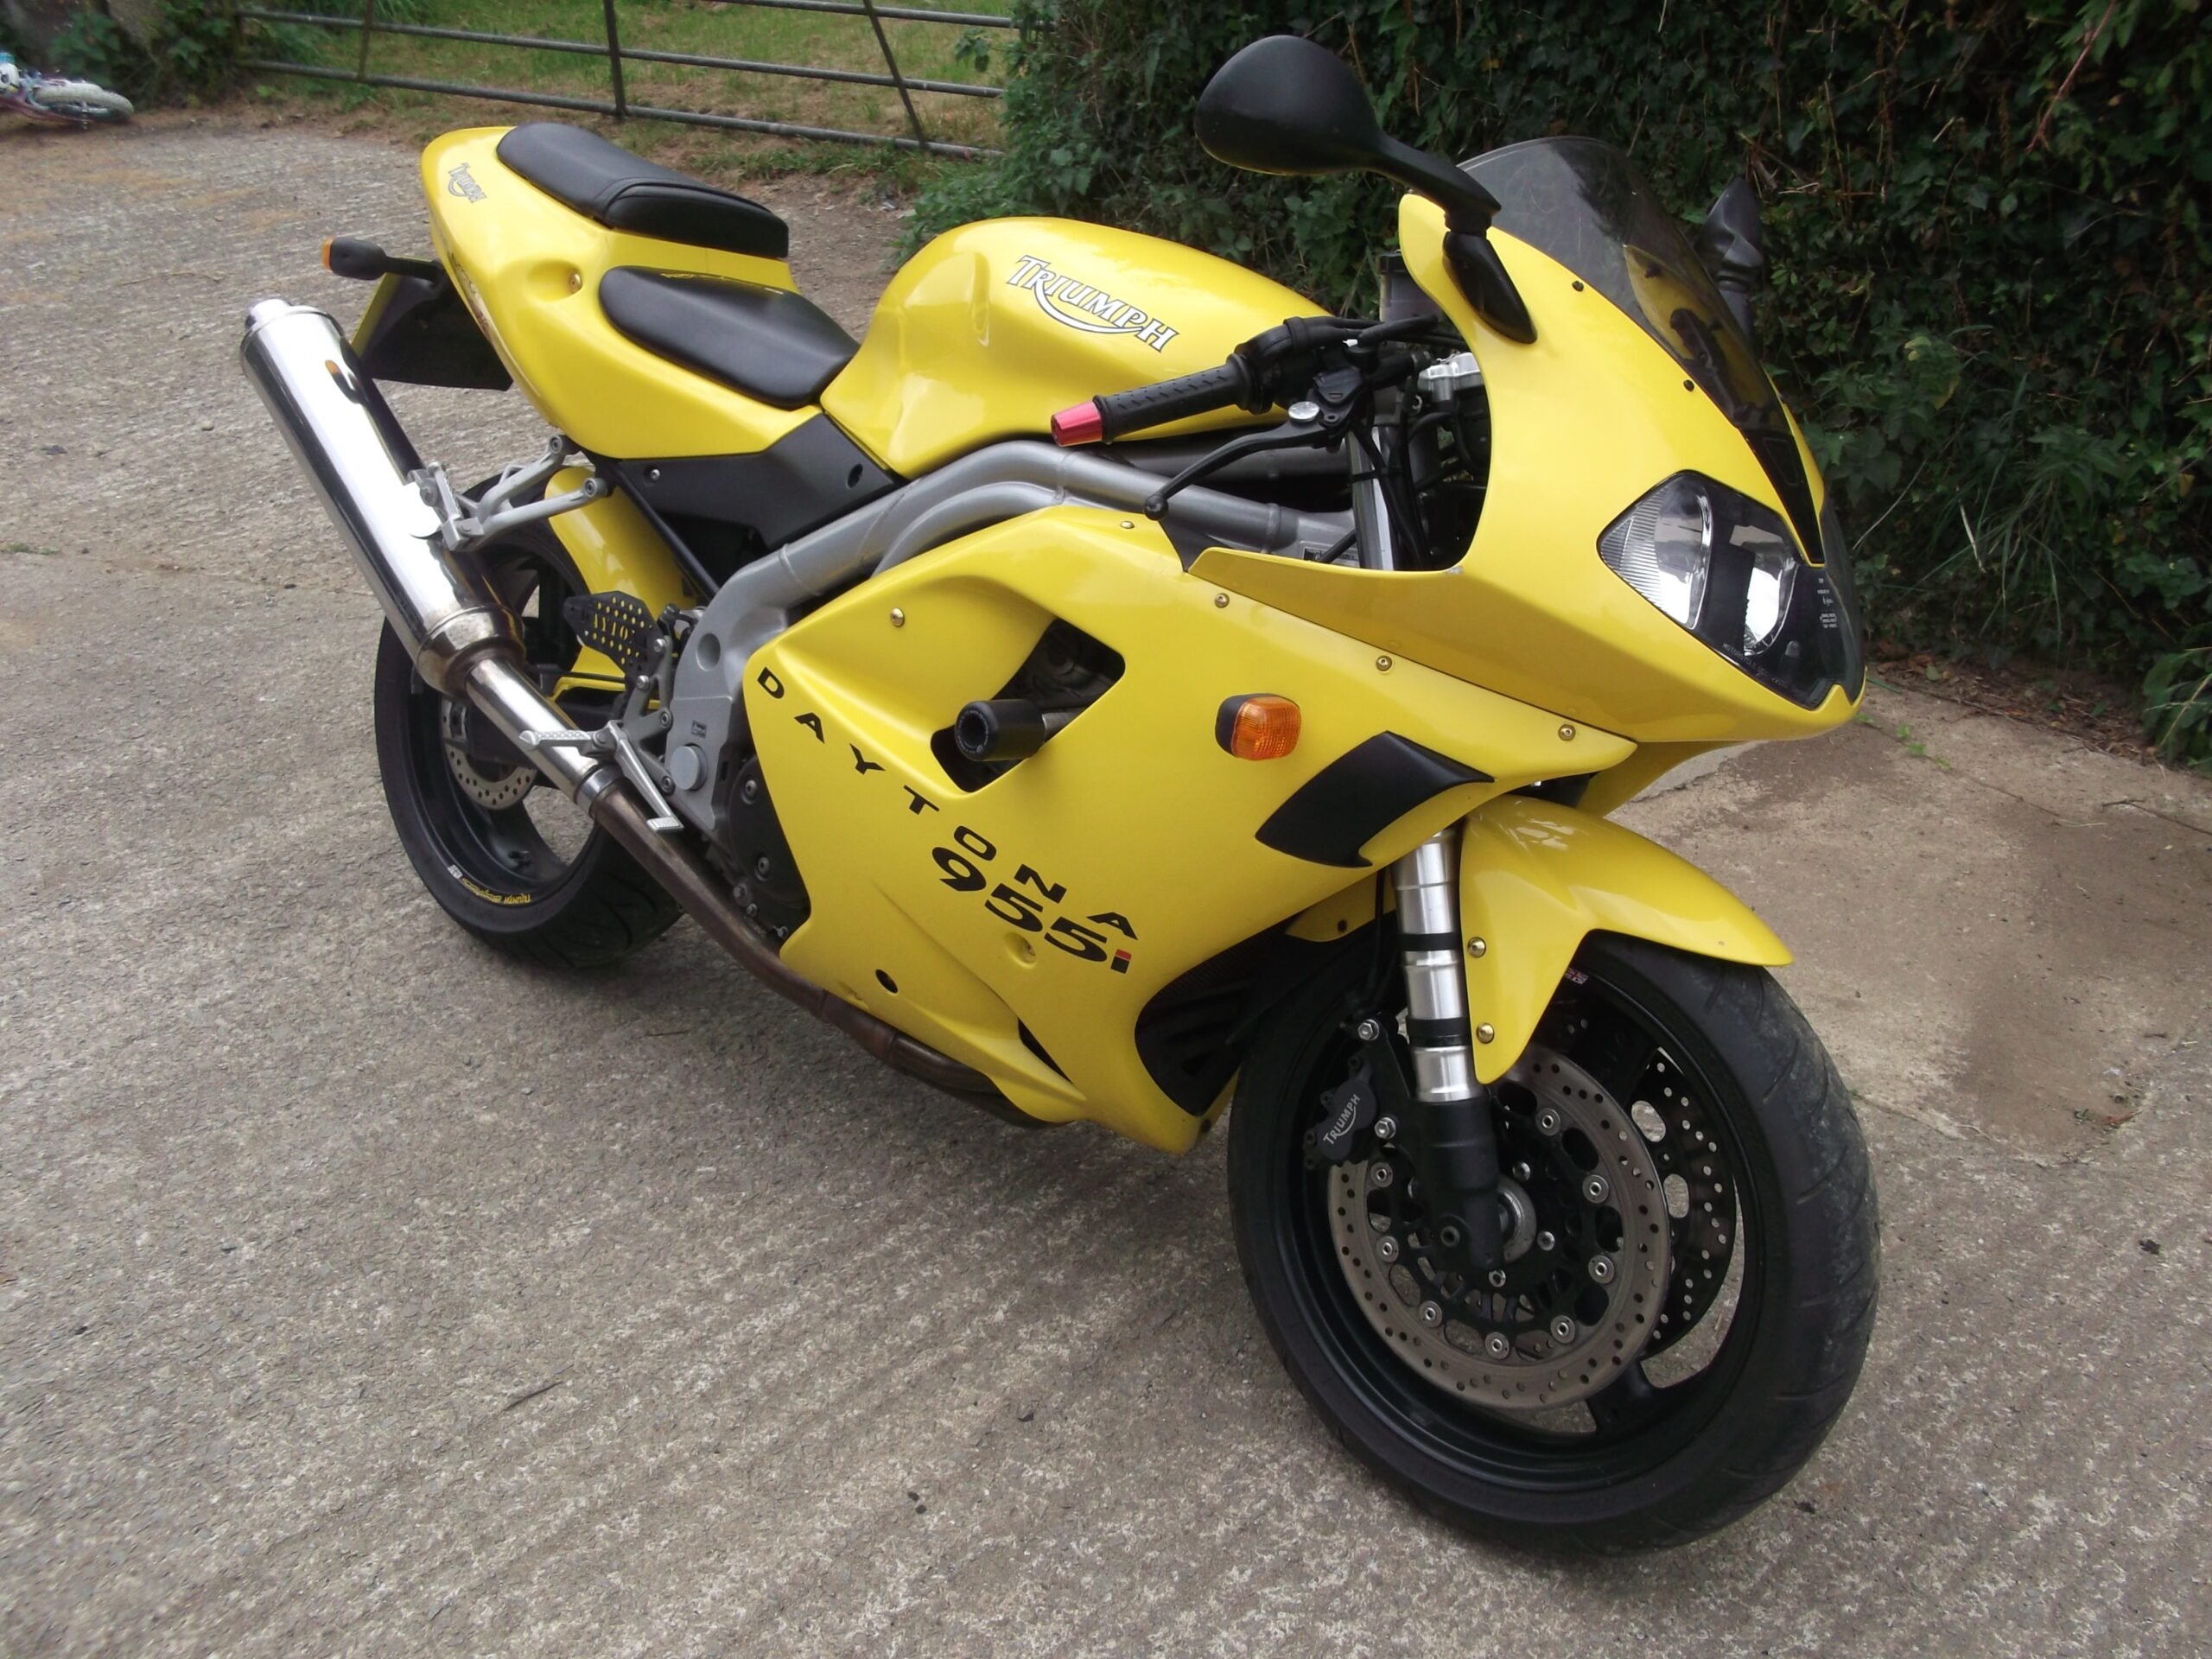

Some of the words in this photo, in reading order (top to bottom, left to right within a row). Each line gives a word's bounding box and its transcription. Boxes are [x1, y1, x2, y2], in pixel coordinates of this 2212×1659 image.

[1006, 254, 1180, 353] TRIUMPH
[757, 666, 1138, 941] DAYTONA
[931, 846, 1132, 974] 955i
[1322, 1093, 1361, 1145] TRIUMPH
